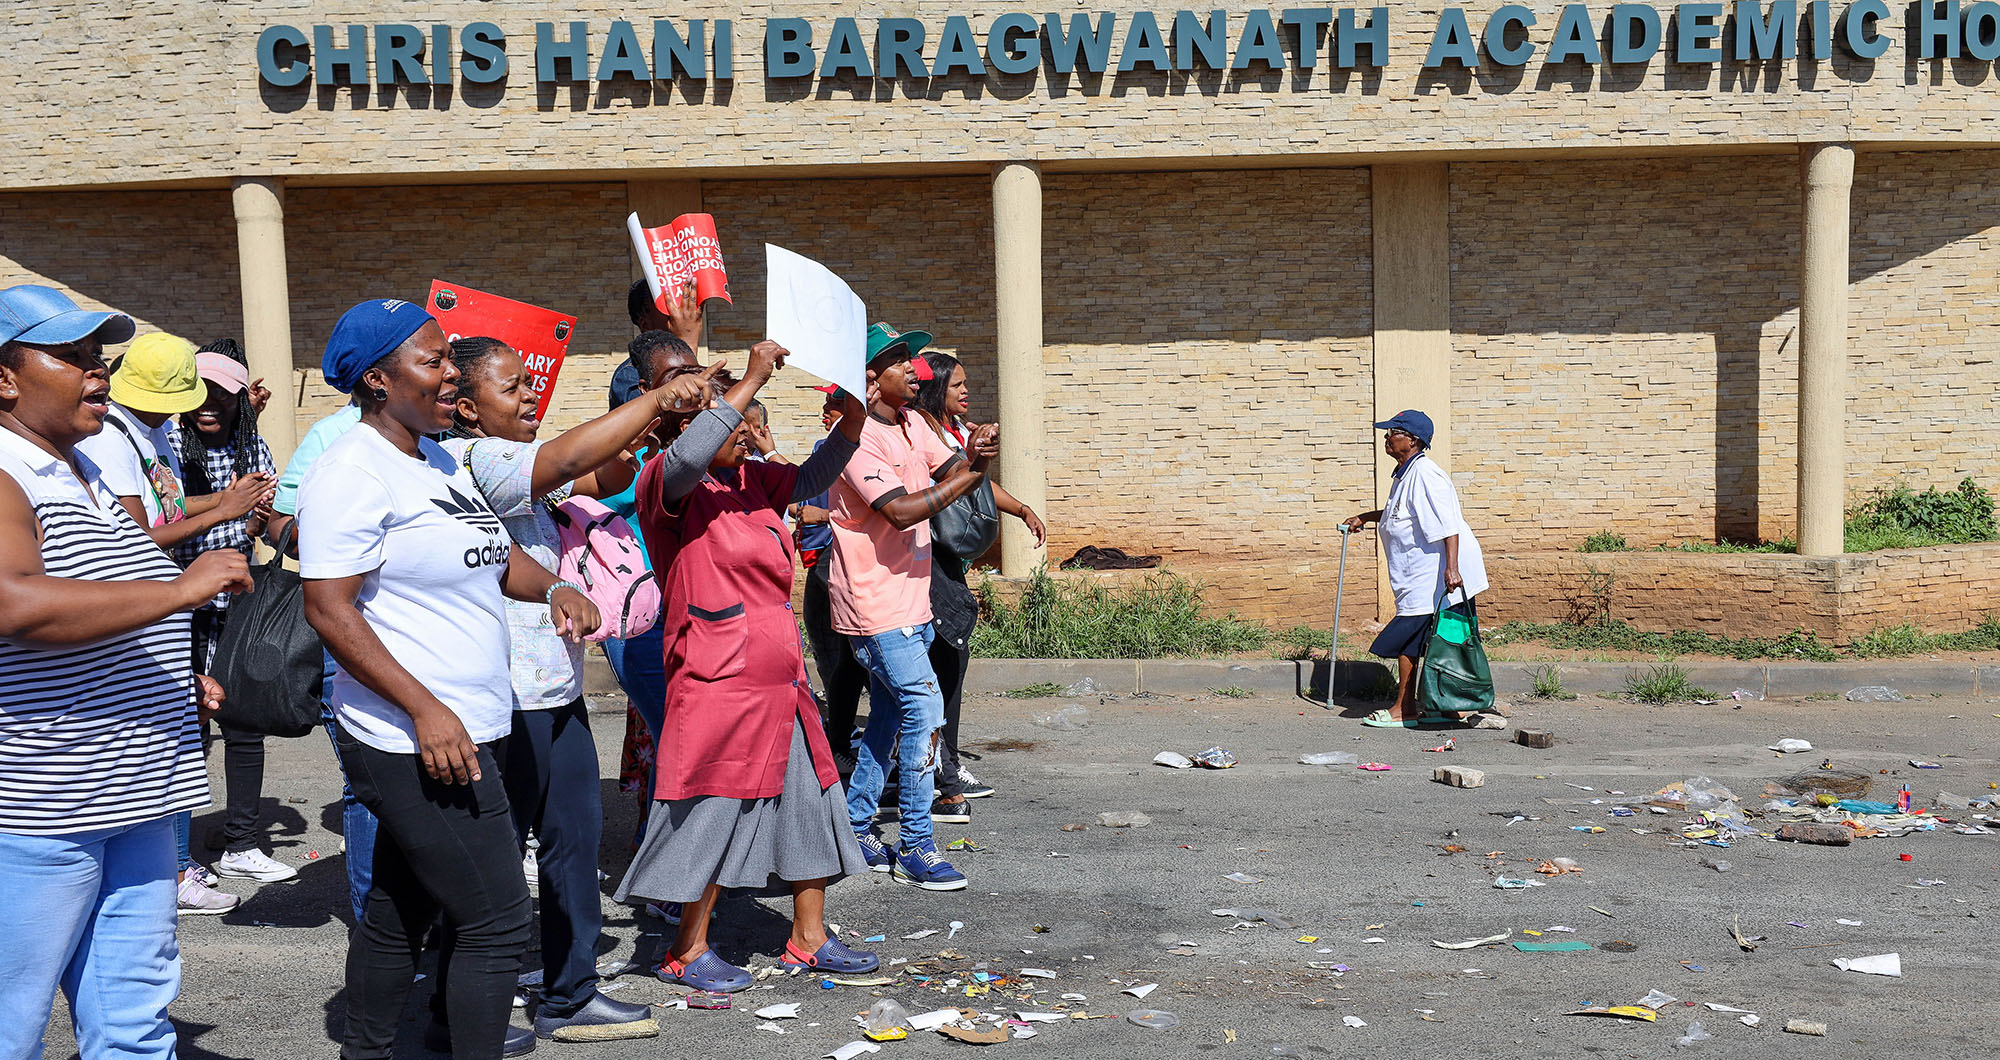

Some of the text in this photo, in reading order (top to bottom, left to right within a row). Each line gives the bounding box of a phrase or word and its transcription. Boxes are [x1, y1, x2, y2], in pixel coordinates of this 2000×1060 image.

[257, 0, 2000, 86] CHRIS HANI BARAGWANATH ACADEMIC HO
[652, 226, 696, 252] NOTCH
[653, 248, 682, 264] THE
[517, 349, 557, 374] ARY
